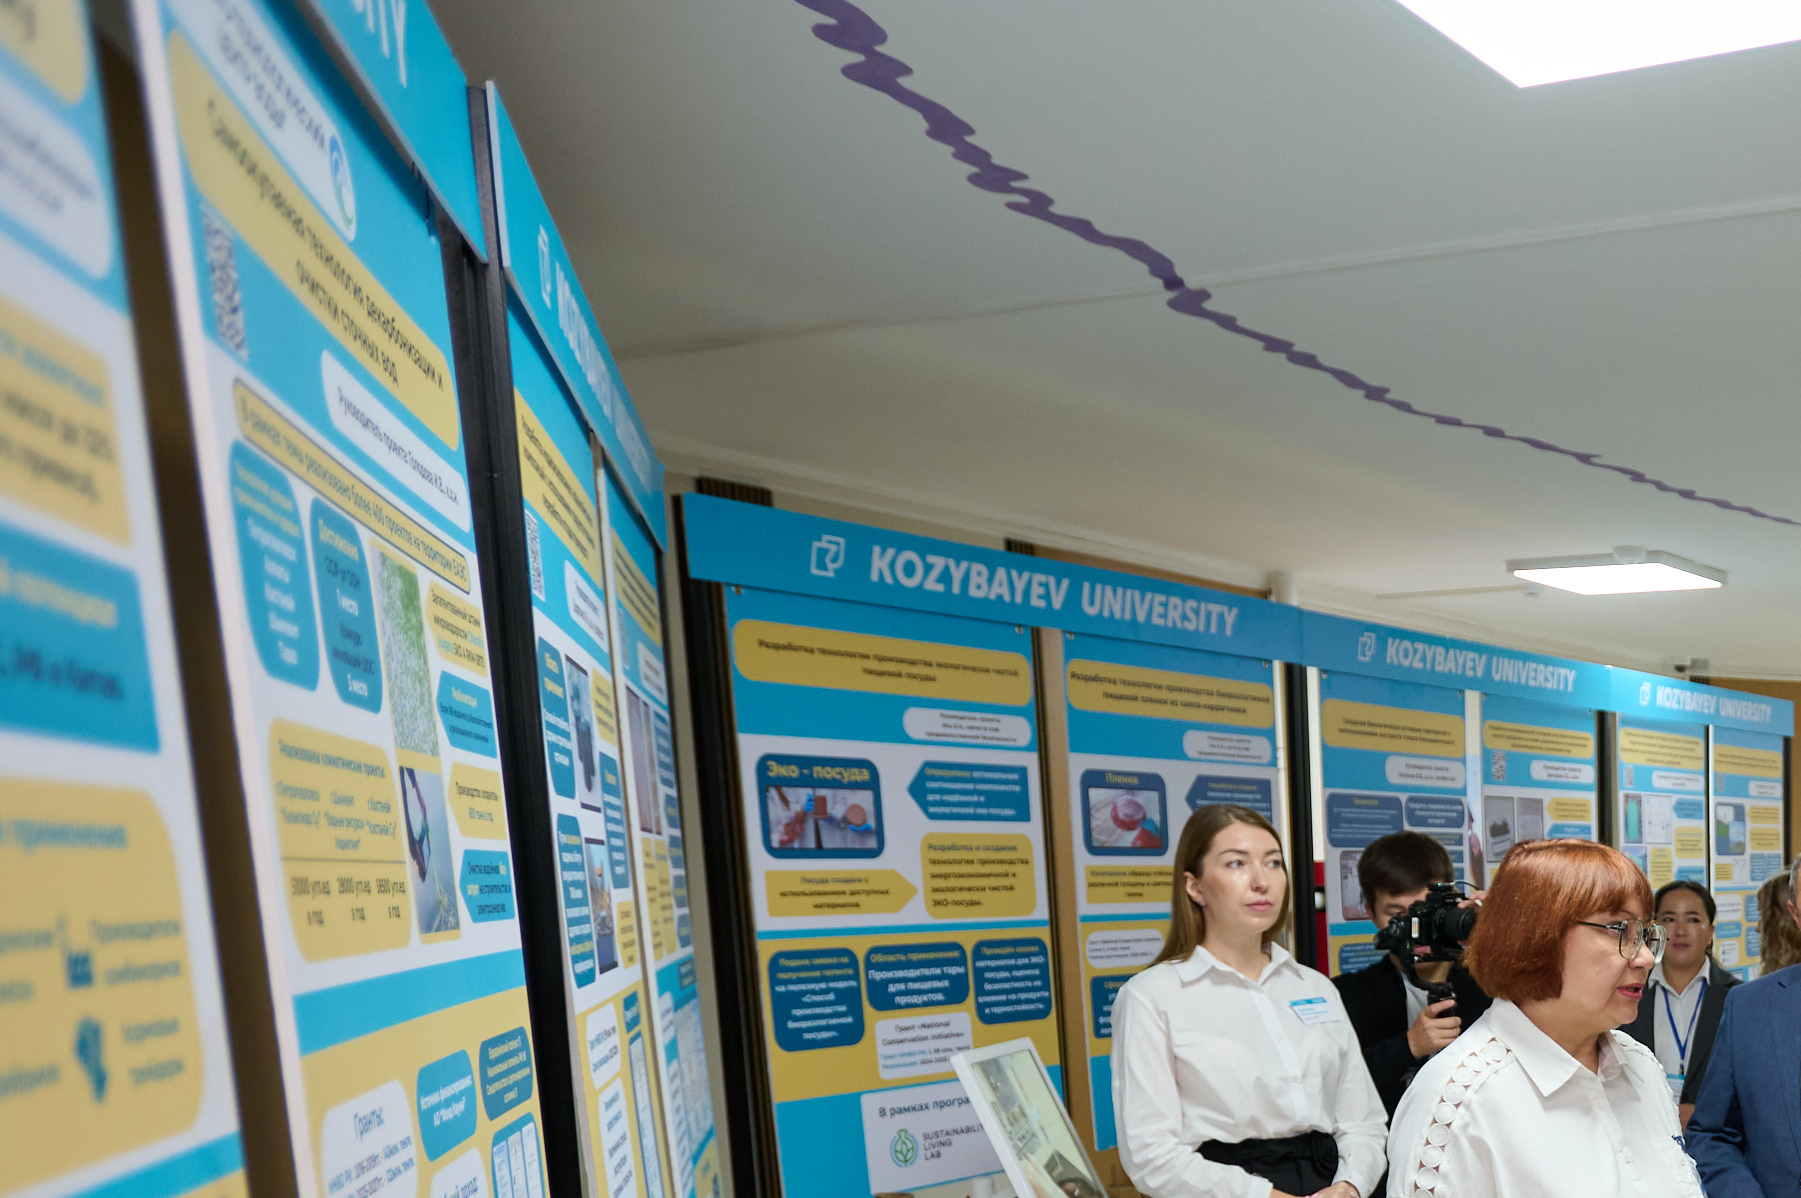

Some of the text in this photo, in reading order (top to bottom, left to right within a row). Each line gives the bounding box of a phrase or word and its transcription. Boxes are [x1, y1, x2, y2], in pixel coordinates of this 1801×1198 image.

[306, 226, 364, 304] технология
[366, 295, 436, 387] декарбонизации
[297, 259, 399, 388] очистки сточных вод
[870, 545, 1239, 638] KOZYBAYEV UNIVERSITY
[1386, 638, 1576, 692] KOZYBAYEV UNIVERSITY
[1656, 682, 1773, 723] KOZYBAYEV UNIVERSITY
[765, 760, 798, 778] Эко
[811, 764, 870, 783] посуда
[867, 965, 965, 980] Производители тары
[887, 978, 949, 992] для пищевых
[894, 992, 944, 1005] продуктов.
[881, 1034, 929, 1045] Conservation
[879, 1096, 970, 1118] В рамках програ
[353, 1103, 383, 1141] Гранты:
[922, 1123, 983, 1141] SUSTAINABILIT
[923, 1139, 952, 1151] LIVING
[924, 1151, 941, 1161] LAB
